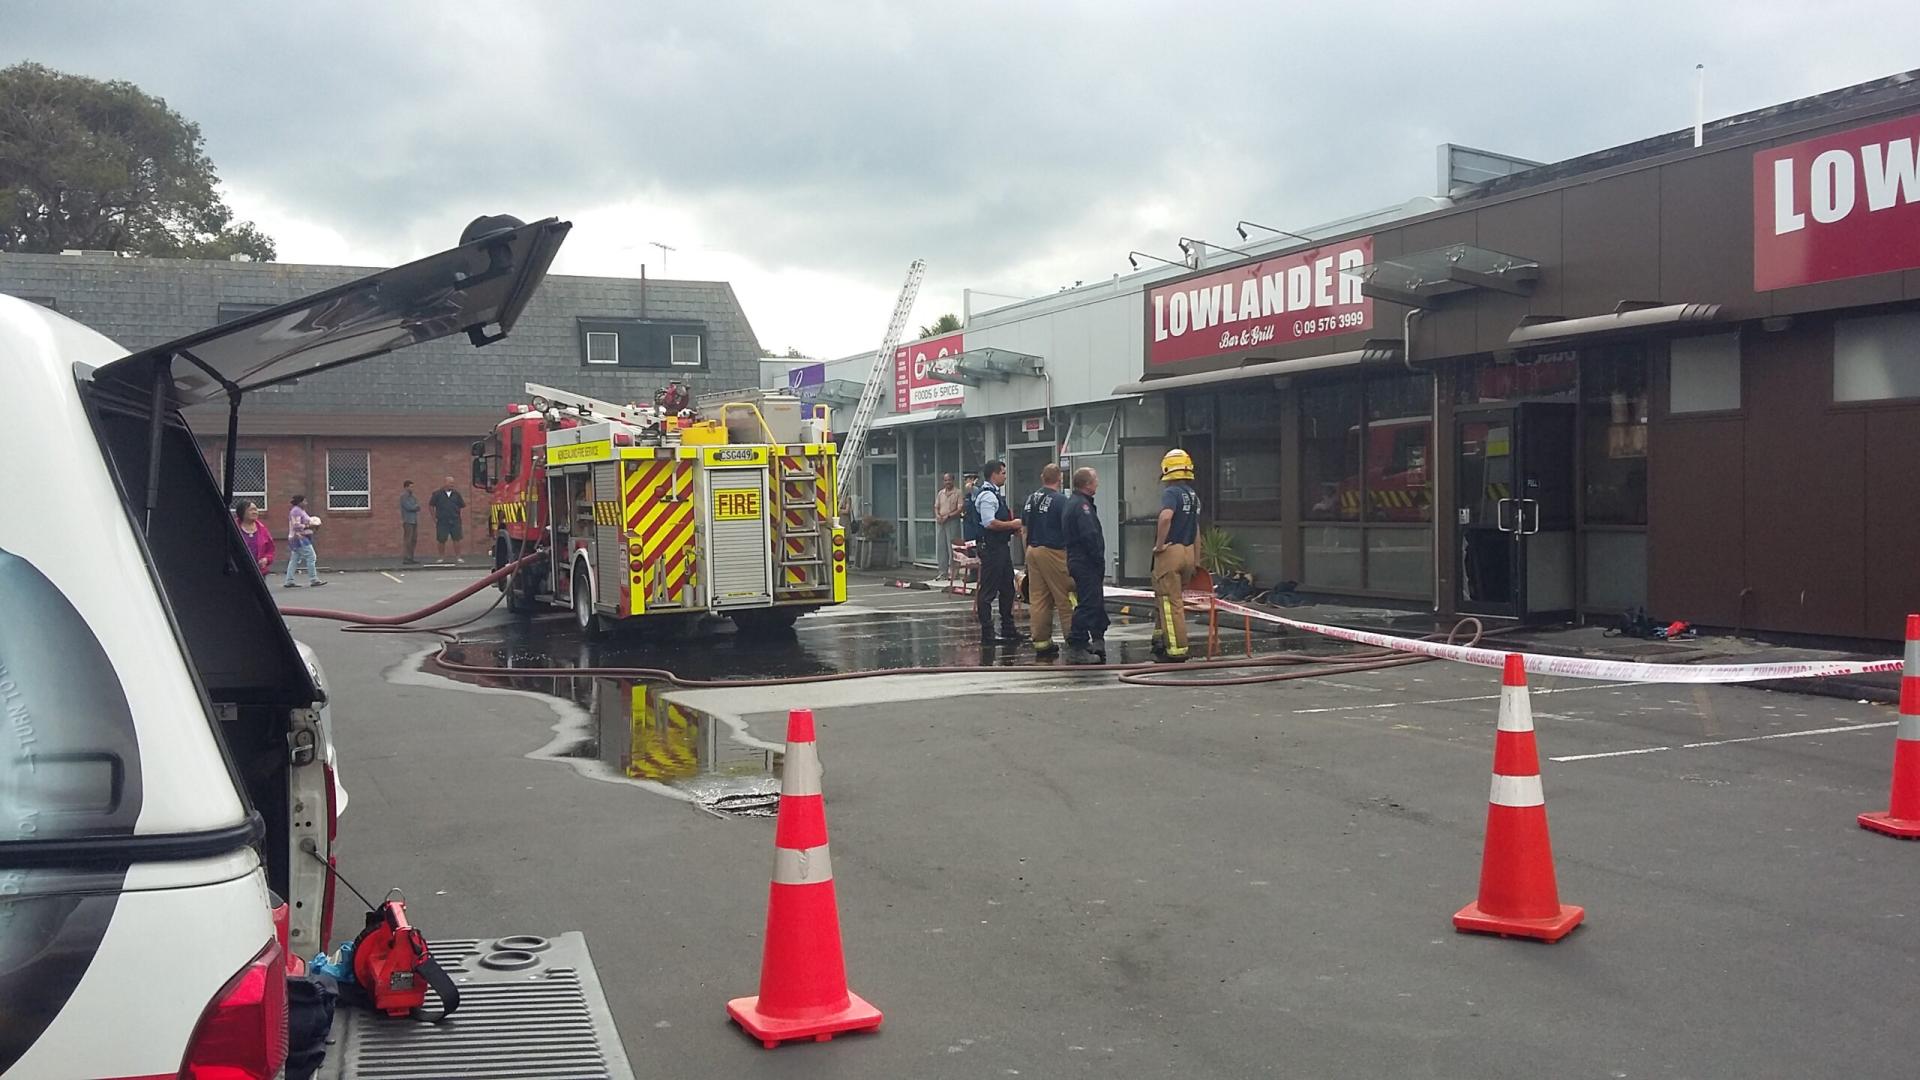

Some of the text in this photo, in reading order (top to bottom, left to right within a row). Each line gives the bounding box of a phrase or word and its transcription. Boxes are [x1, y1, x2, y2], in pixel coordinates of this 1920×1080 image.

[1155, 249, 1364, 342] LOWLANDER
[1304, 311, 1364, 334] 09 576 3999
[1219, 325, 1275, 348] Bar & Grill
[914, 389, 932, 400] FOODS
[940, 384, 959, 397] SPICES
[721, 449, 752, 460] CSG449
[719, 493, 757, 515] FIRE
[7, 703, 38, 749] TURN
